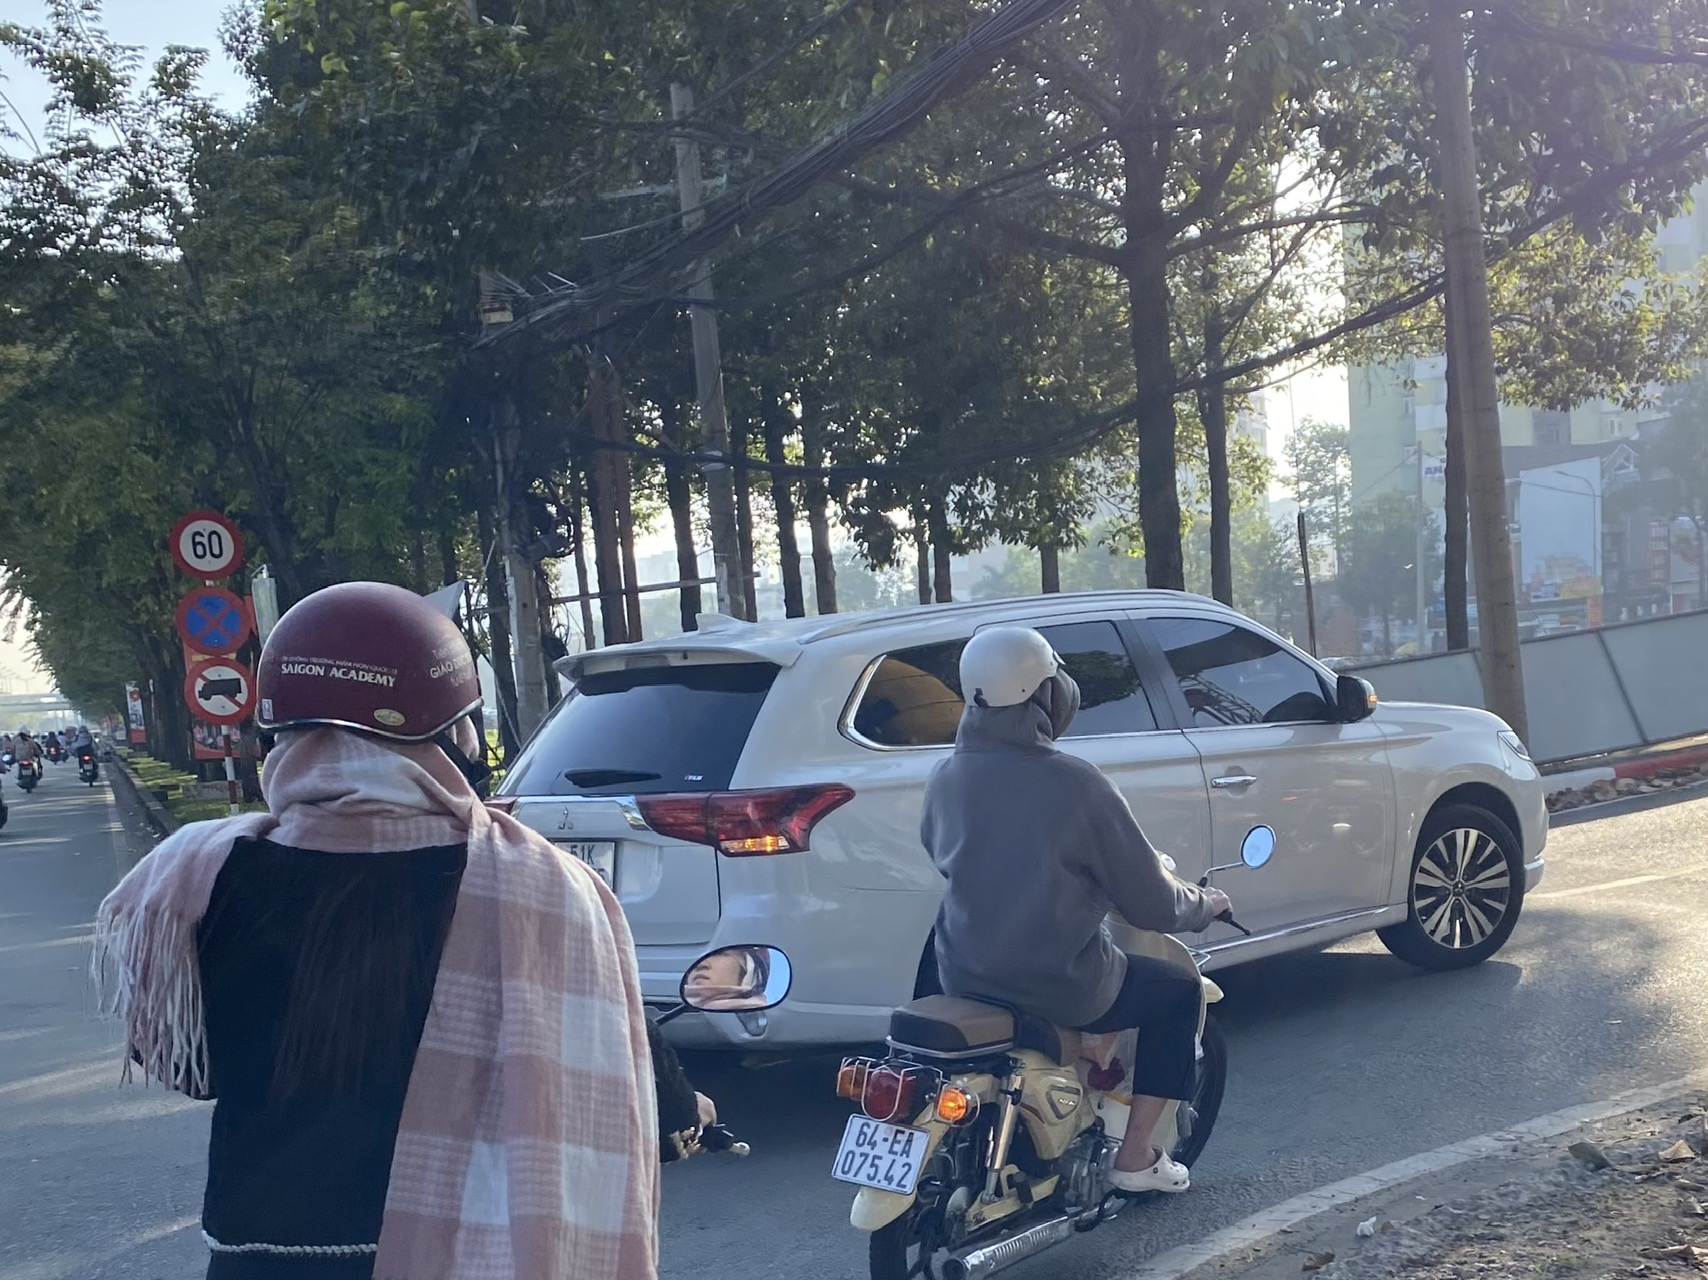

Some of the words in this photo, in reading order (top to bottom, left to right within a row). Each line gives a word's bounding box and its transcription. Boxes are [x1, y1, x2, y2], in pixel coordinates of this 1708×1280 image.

[191, 529, 224, 560] 60
[281, 662, 325, 676] SAIGON
[329, 667, 396, 688] ACADEMY
[855, 1121, 916, 1159] 64-EA
[841, 1149, 913, 1190] 075.42
